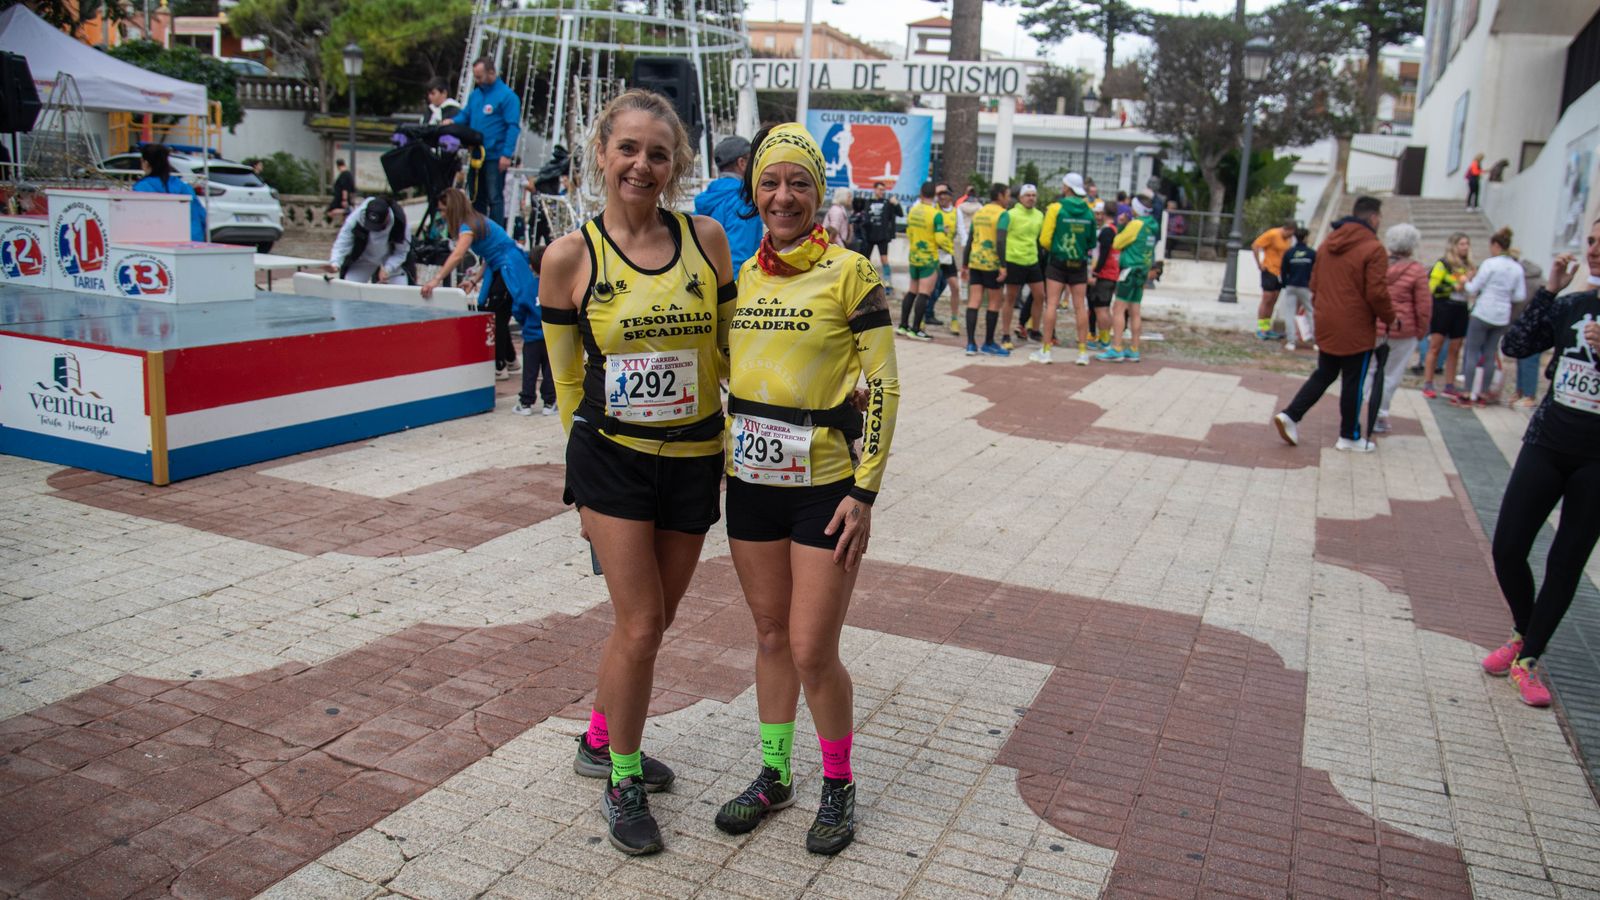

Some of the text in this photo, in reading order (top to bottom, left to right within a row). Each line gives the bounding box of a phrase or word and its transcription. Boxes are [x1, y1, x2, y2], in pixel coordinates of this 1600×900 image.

[735, 63, 1019, 96] OFICIA DE TURISMO
[820, 112, 909, 127] CLUB DEPORTIVO
[74, 213, 89, 263] 1
[17, 233, 35, 264] 2
[73, 275, 106, 291] TARIFA
[140, 260, 161, 290] 3
[620, 312, 713, 329] TESORILLO
[623, 324, 713, 341] SECADERO
[621, 357, 651, 371] XIV
[651, 356, 680, 364] CARRERA
[665, 361, 694, 370] ESTRECHO
[628, 369, 677, 398] 292
[1567, 372, 1600, 396] 463
[29, 391, 115, 424] ventura
[37, 414, 63, 428] Tarifa
[743, 418, 761, 433] XIV
[760, 423, 791, 433] CARRERA
[773, 432, 807, 441] ESTRECHO
[744, 433, 785, 464] 293
